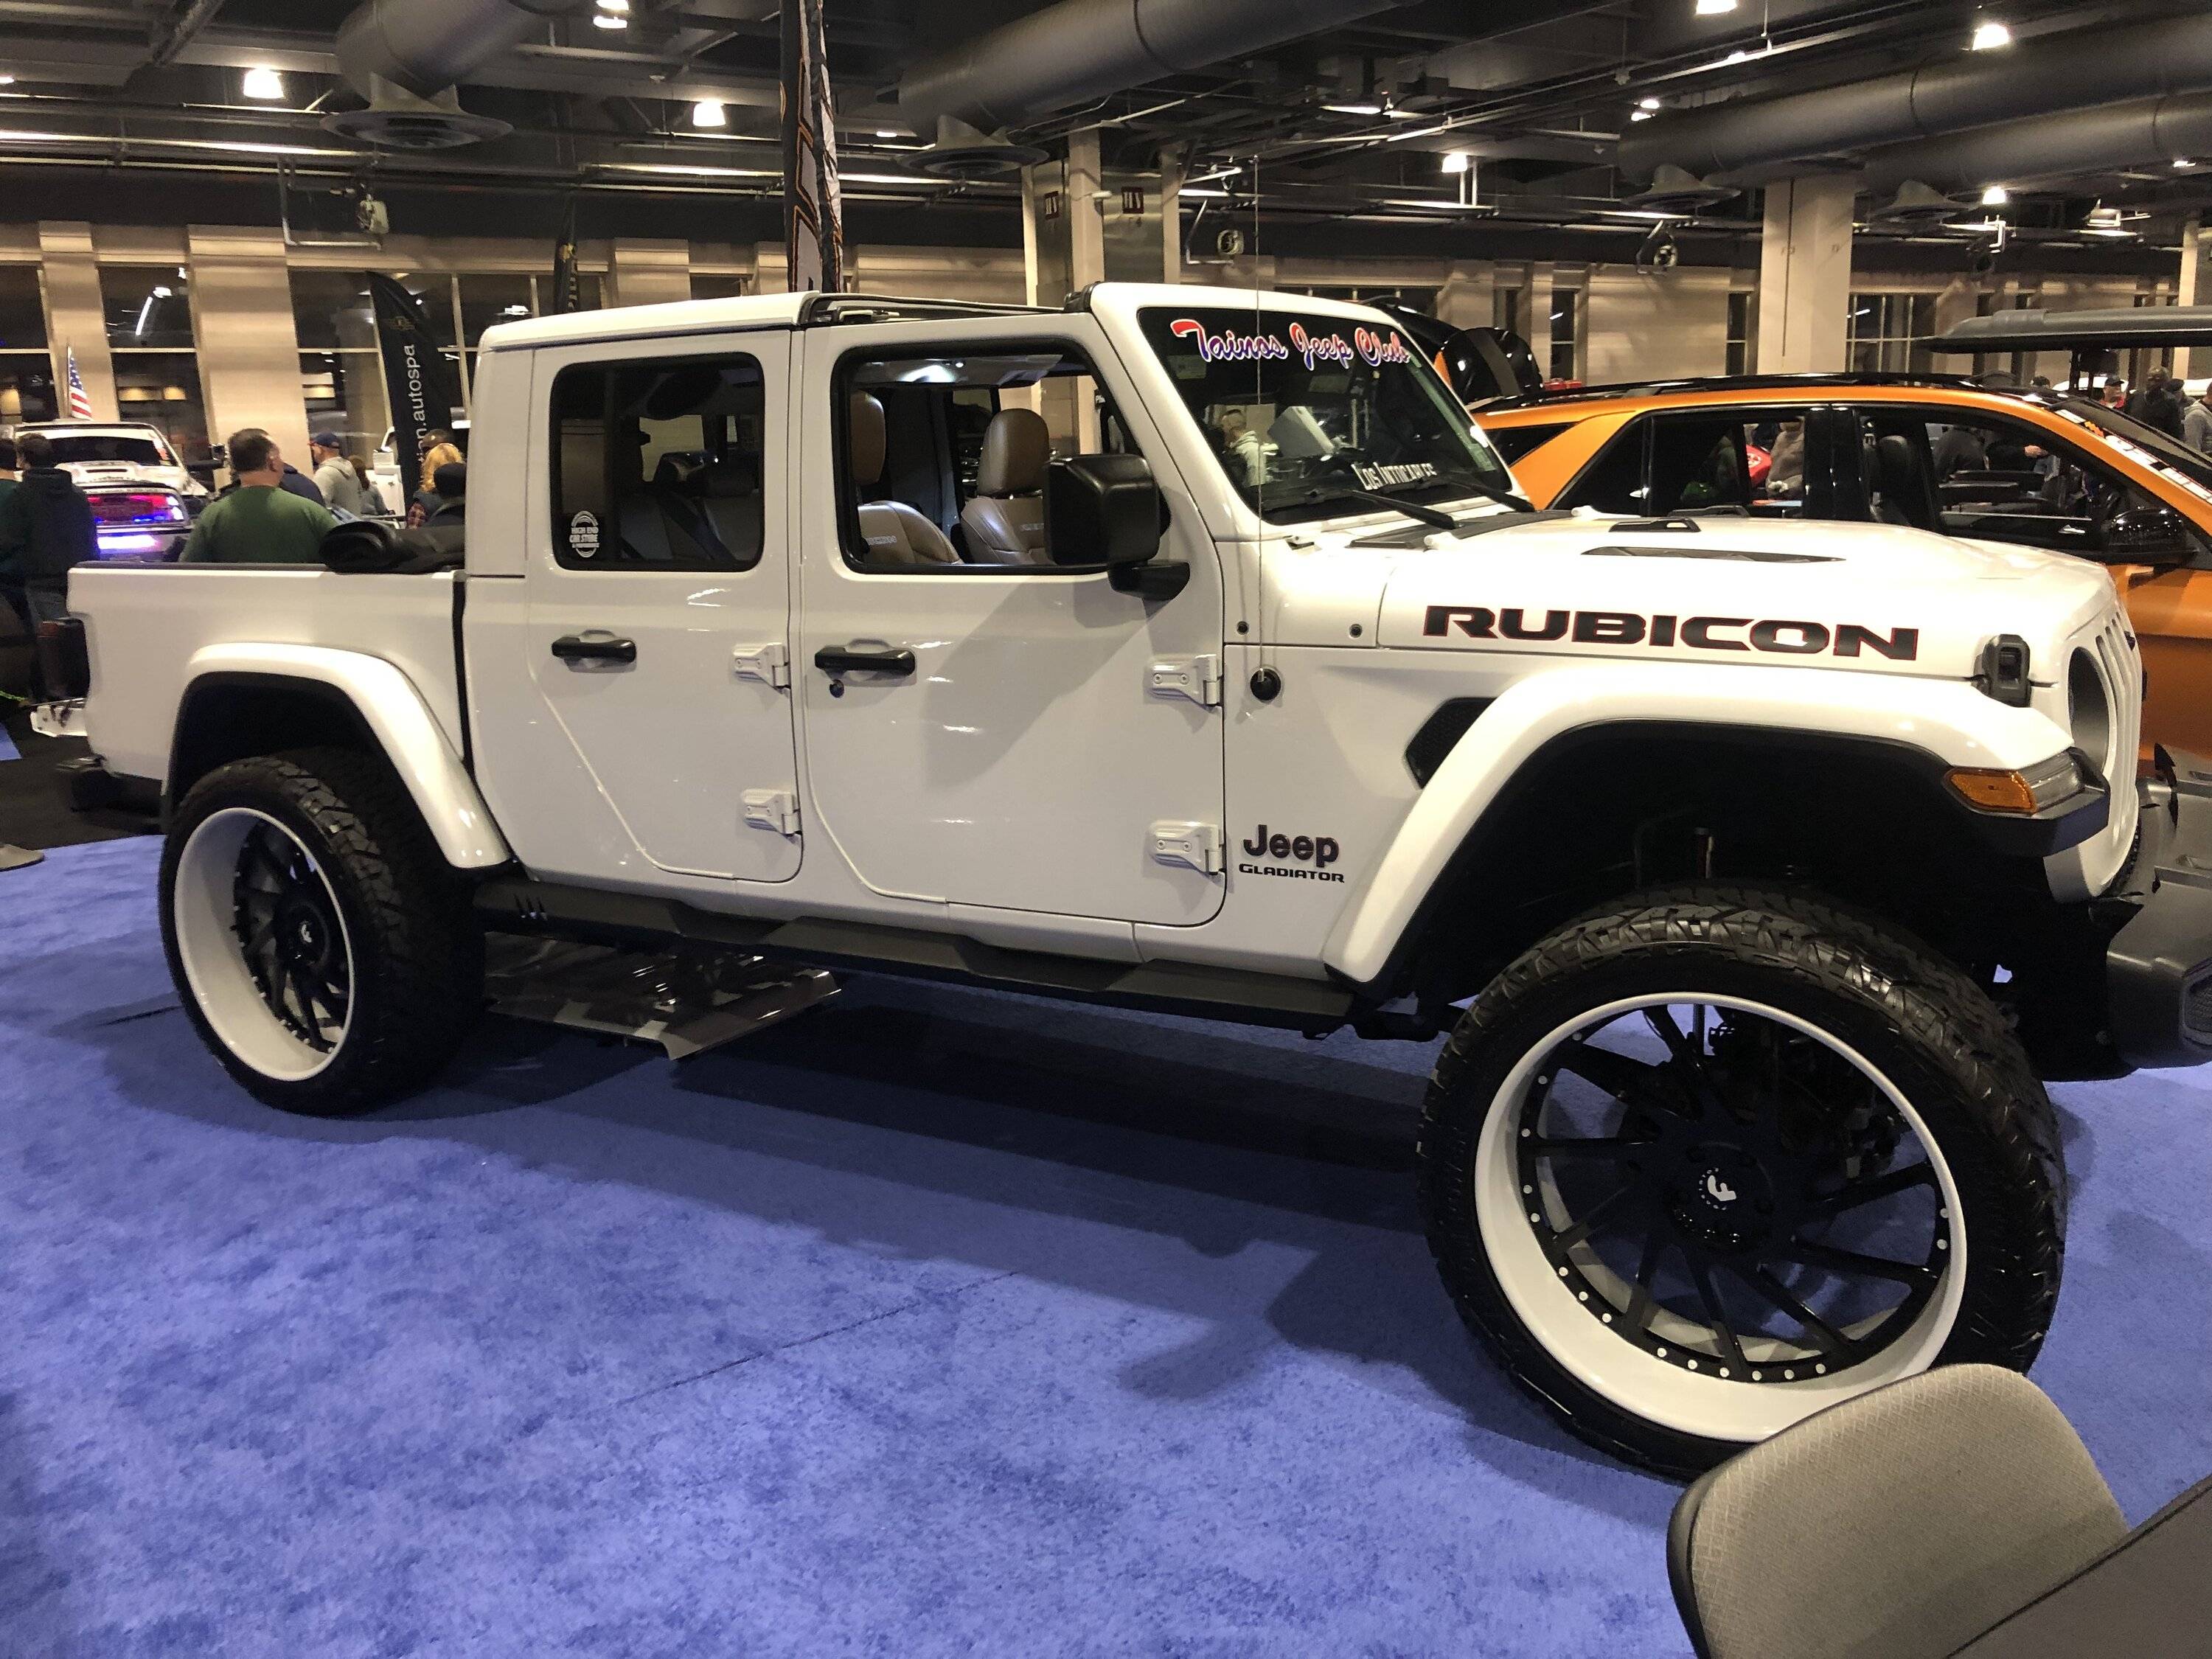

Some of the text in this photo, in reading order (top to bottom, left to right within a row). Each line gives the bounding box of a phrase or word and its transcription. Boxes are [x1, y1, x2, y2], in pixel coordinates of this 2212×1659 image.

[1170, 319, 1411, 371] Tainos Jeep Club
[1422, 605, 1919, 661] RUBICON
[1243, 824, 1339, 868] Jeep
[1239, 863, 1345, 883] GLADIATOR
